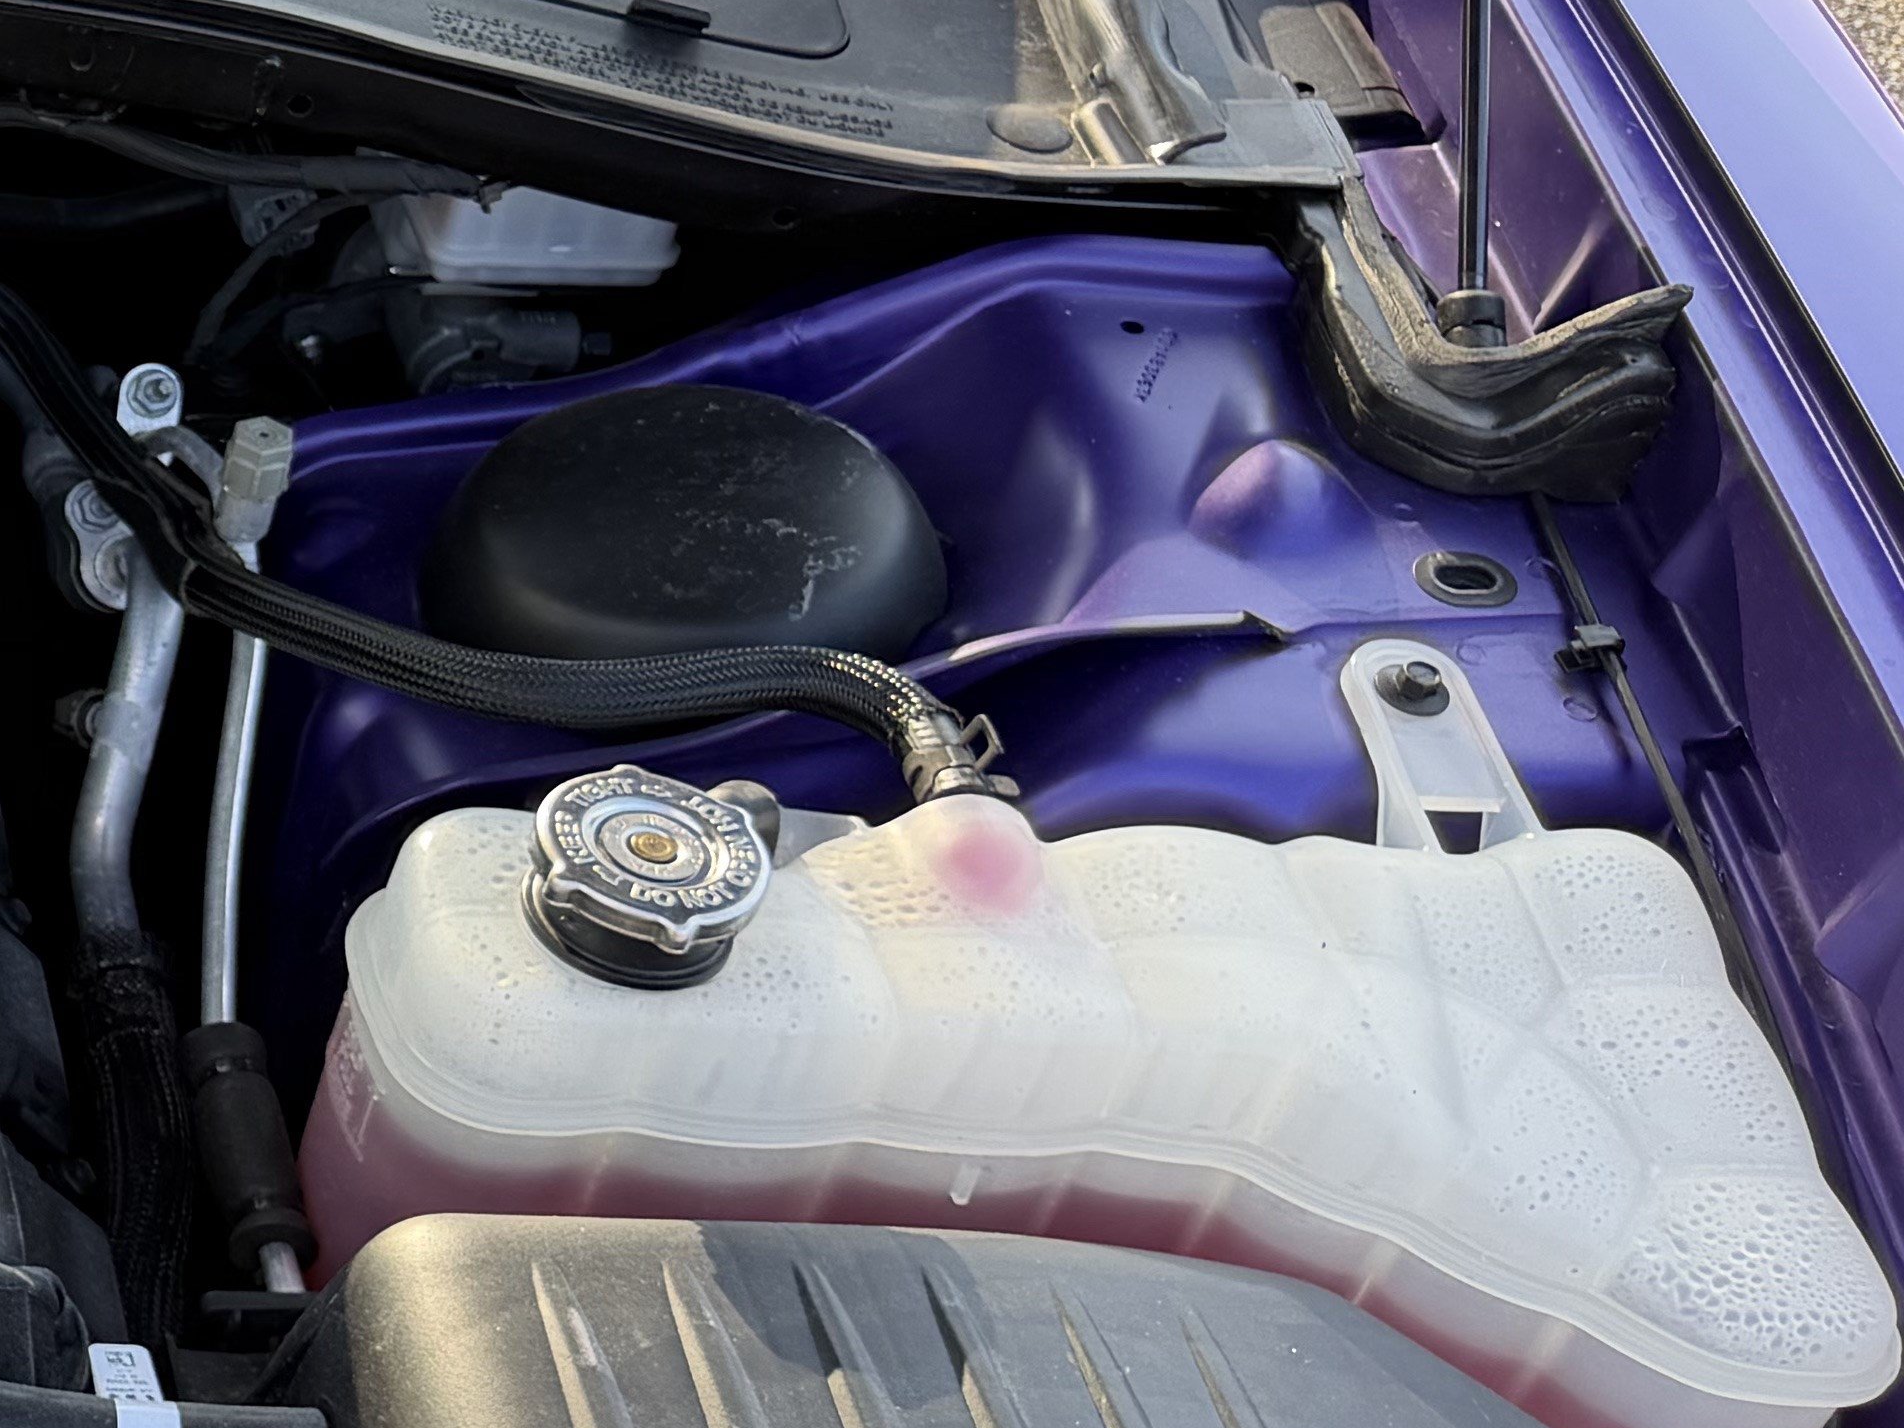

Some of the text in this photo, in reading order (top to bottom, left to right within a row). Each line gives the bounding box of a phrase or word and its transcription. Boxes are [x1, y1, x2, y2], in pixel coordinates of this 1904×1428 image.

[554, 776, 635, 865] KEEP TIGHT
[629, 882, 678, 908] DO
[677, 881, 735, 909] NOT
